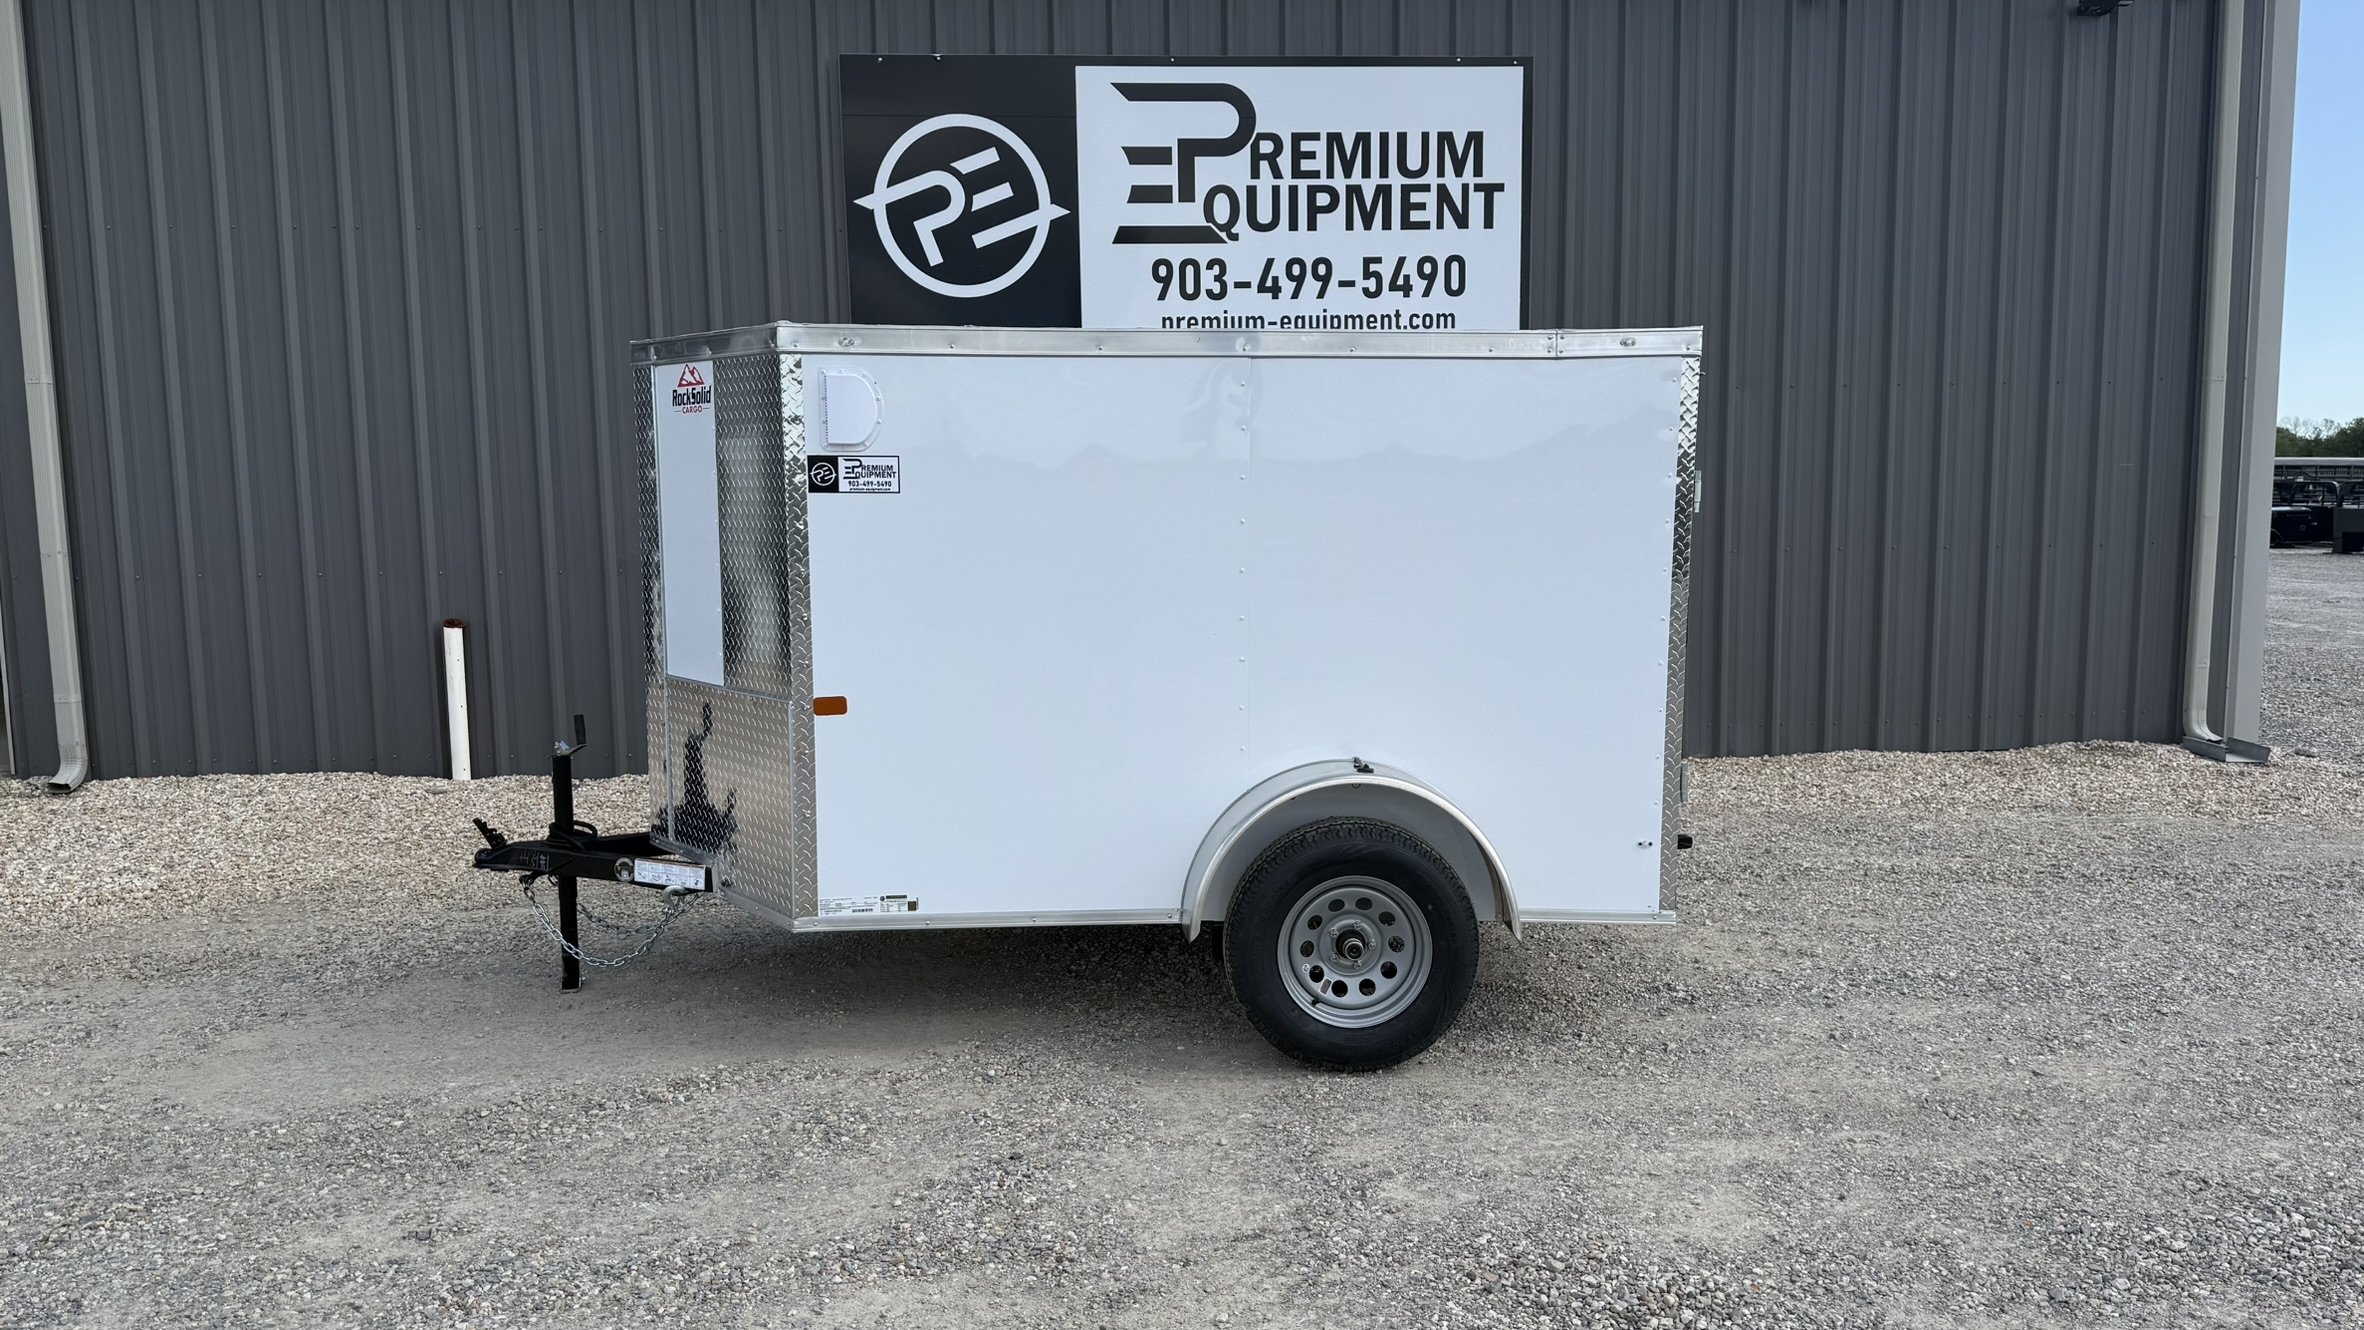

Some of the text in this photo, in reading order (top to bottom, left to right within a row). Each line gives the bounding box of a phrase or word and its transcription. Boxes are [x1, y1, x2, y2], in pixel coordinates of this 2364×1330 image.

[1110, 82, 1484, 202] PREMIUM
[1112, 146, 1505, 244] EQUIPMENT
[1151, 254, 1467, 301] 903-499-5490
[672, 386, 711, 407] RockSolid
[682, 405, 703, 414] CARGO
[843, 458, 893, 474] PREMIUM
[843, 466, 896, 479] EQUIPMENT
